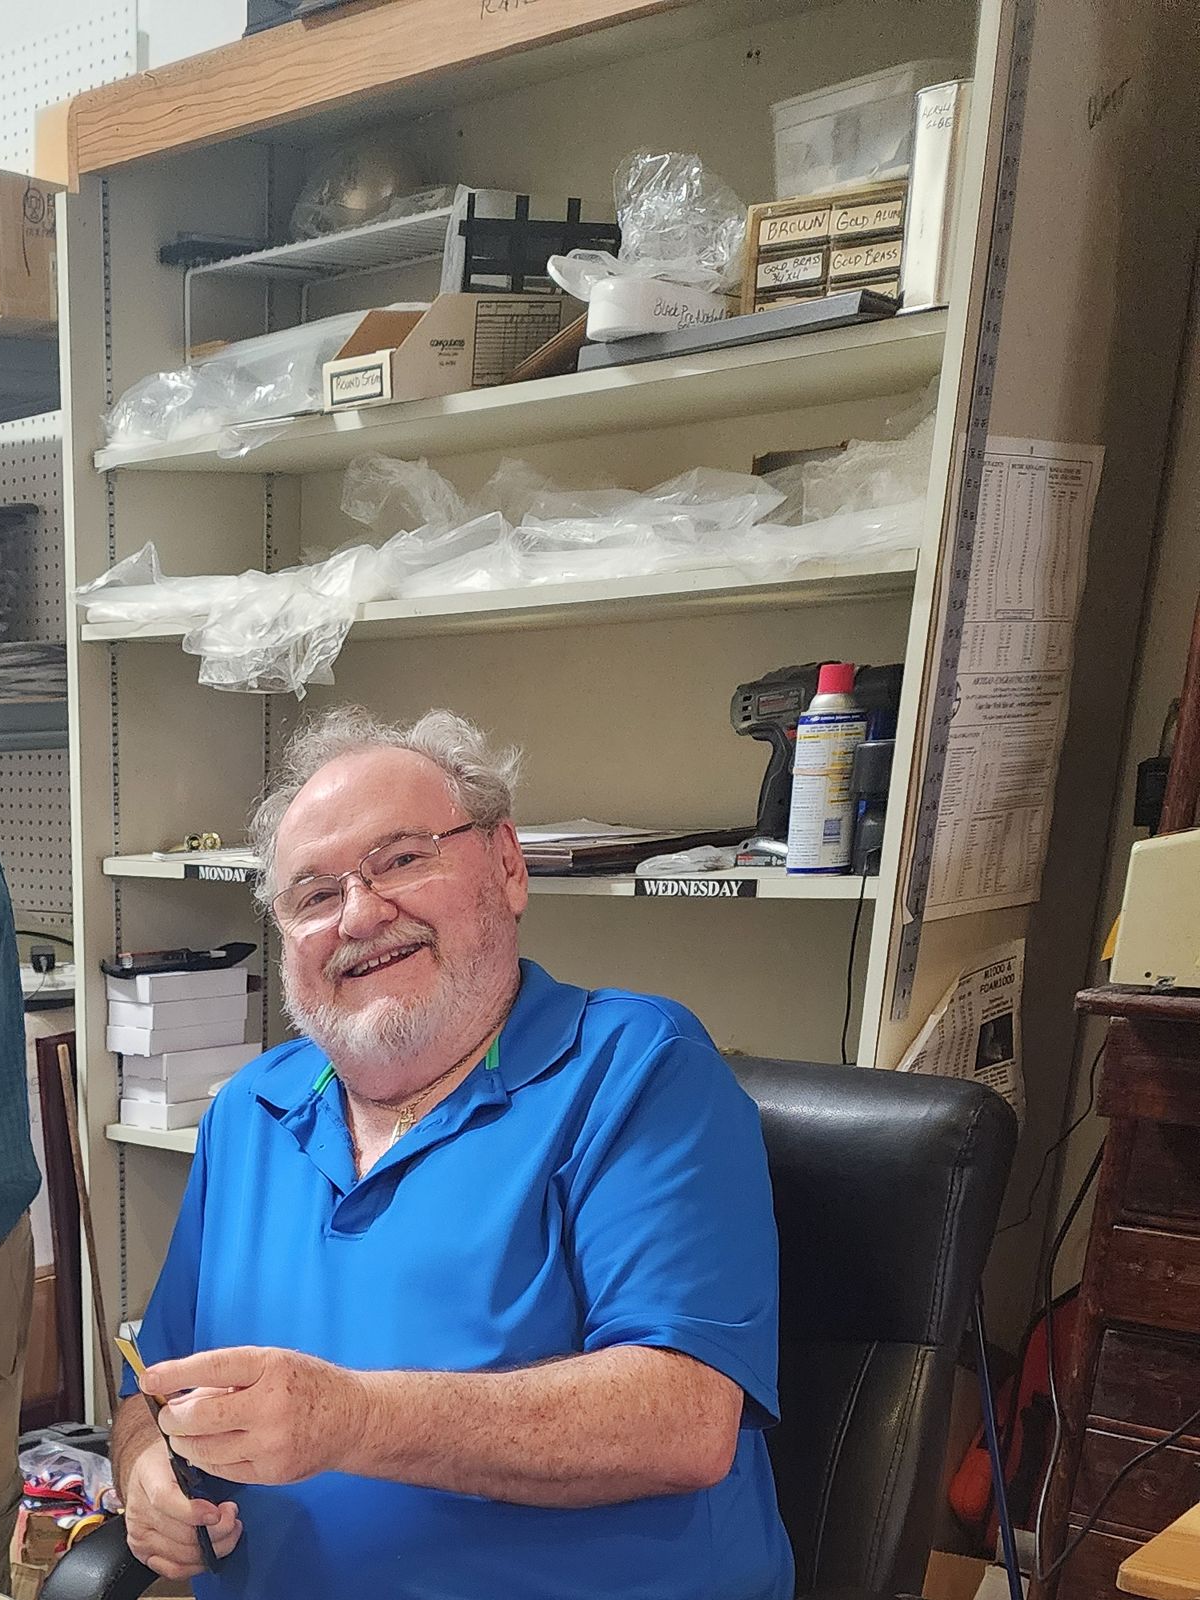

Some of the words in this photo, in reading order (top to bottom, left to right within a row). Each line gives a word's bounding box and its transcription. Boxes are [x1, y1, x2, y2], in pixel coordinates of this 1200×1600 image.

[767, 213, 825, 240] BROWN
[836, 213, 868, 230] GOLD
[832, 253, 861, 269] GOLD
[864, 247, 897, 264] BRASS
[197, 865, 247, 882] MONDAY
[642, 878, 743, 897] WEDNESDAY
